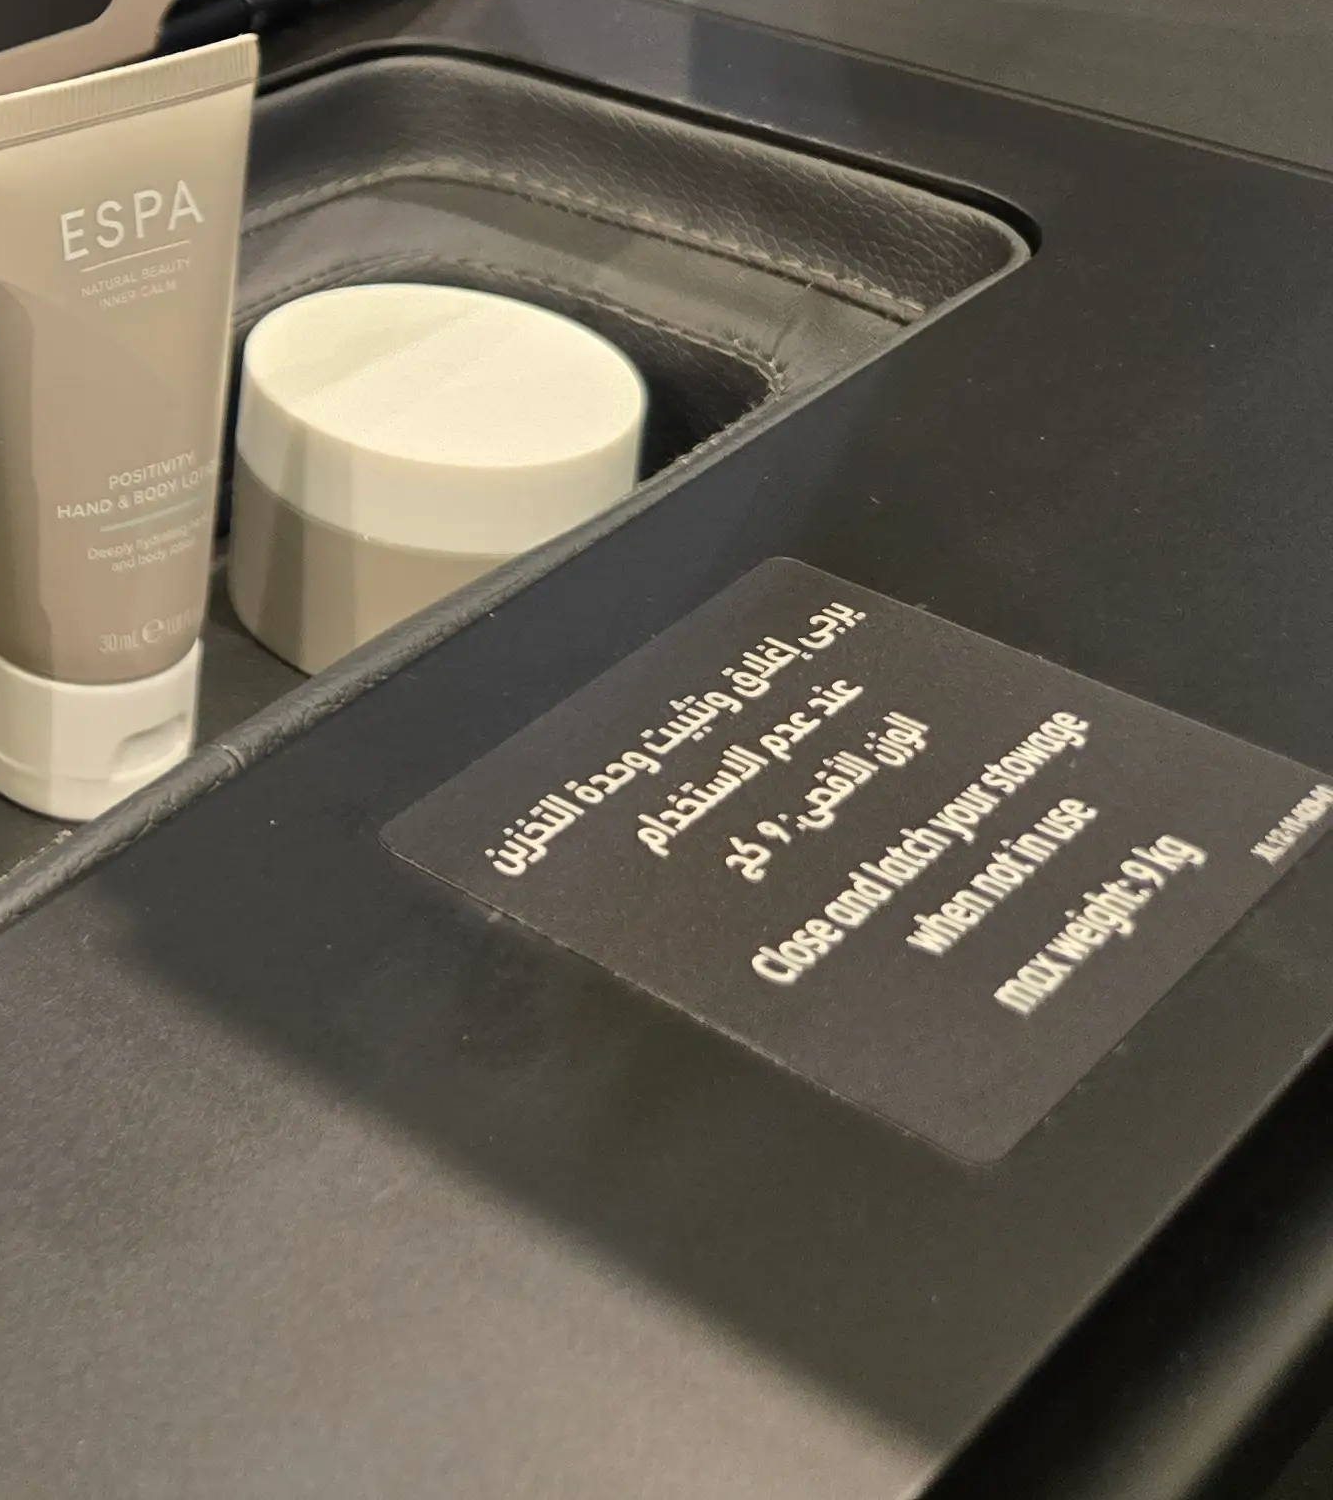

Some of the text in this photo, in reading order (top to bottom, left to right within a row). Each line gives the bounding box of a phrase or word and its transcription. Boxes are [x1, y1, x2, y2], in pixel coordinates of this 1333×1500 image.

[60, 179, 205, 262] ESPA
[80, 258, 191, 298] NATURAL BEAUTY
[99, 279, 177, 310] INNER CALM
[108, 451, 195, 490] POSITIVITY
[57, 499, 113, 519] HAND
[117, 495, 130, 509] &
[133, 480, 178, 504] BODY
[87, 541, 133, 560] Deeply
[111, 556, 135, 572] and
[485, 603, 866, 876] يرجى إغلاق وتثبيت وحدة التخزين
[864, 712, 929, 766] الوزن
[638, 680, 863, 857] عند عدم الاستخدام
[752, 712, 1089, 984] Close and latch your stowage
[906, 799, 1098, 955] when not in use
[994, 835, 1207, 1014] max weight: 9 kg
